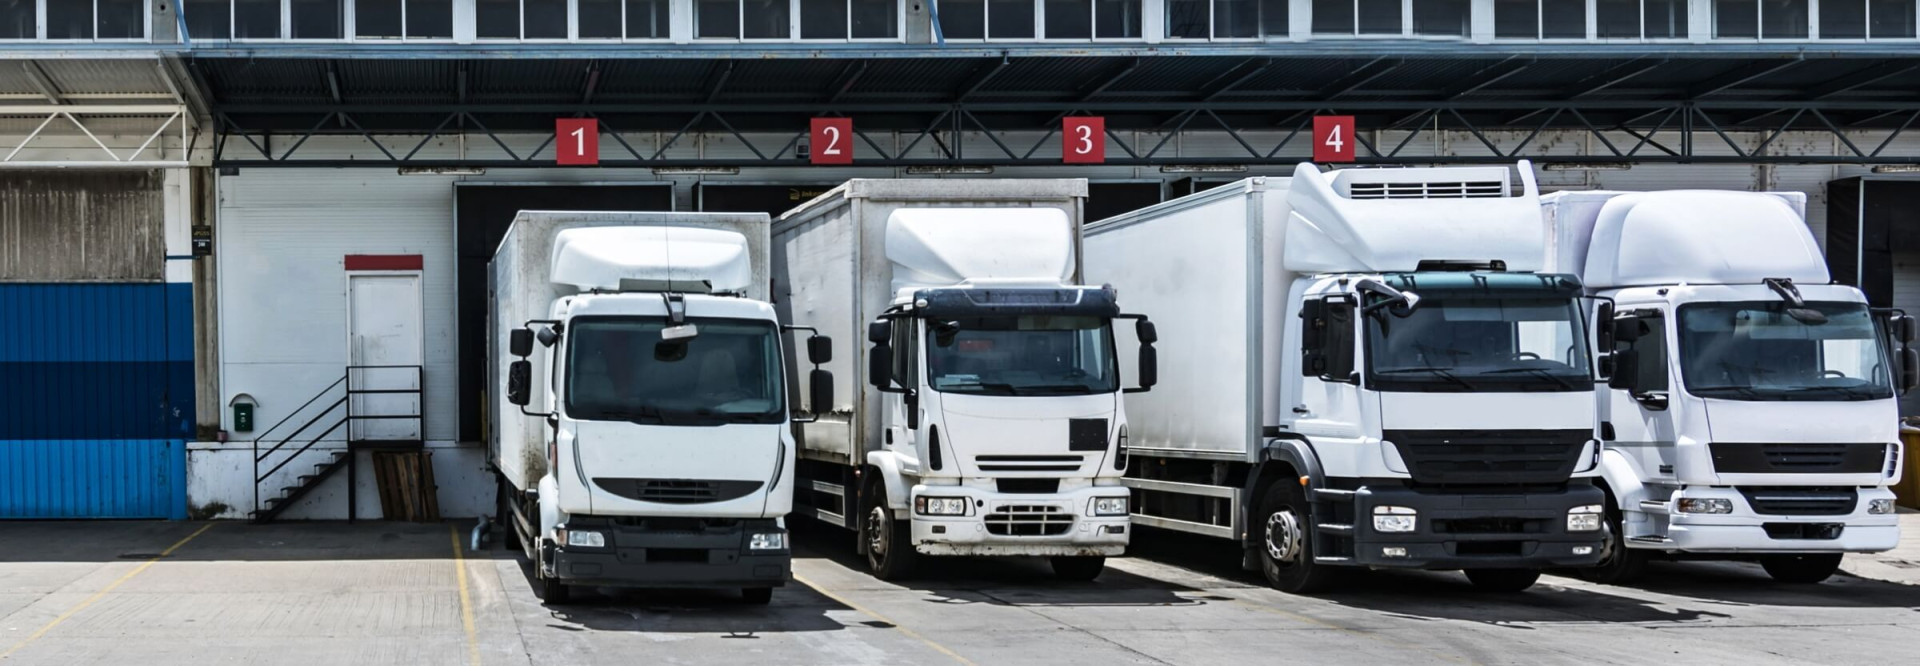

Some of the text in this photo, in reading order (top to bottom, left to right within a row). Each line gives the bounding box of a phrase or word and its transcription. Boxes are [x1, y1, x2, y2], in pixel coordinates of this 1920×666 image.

[571, 128, 584, 156] 1
[823, 127, 841, 155] 2
[1075, 125, 1093, 154] 3
[1325, 124, 1344, 153] 4
